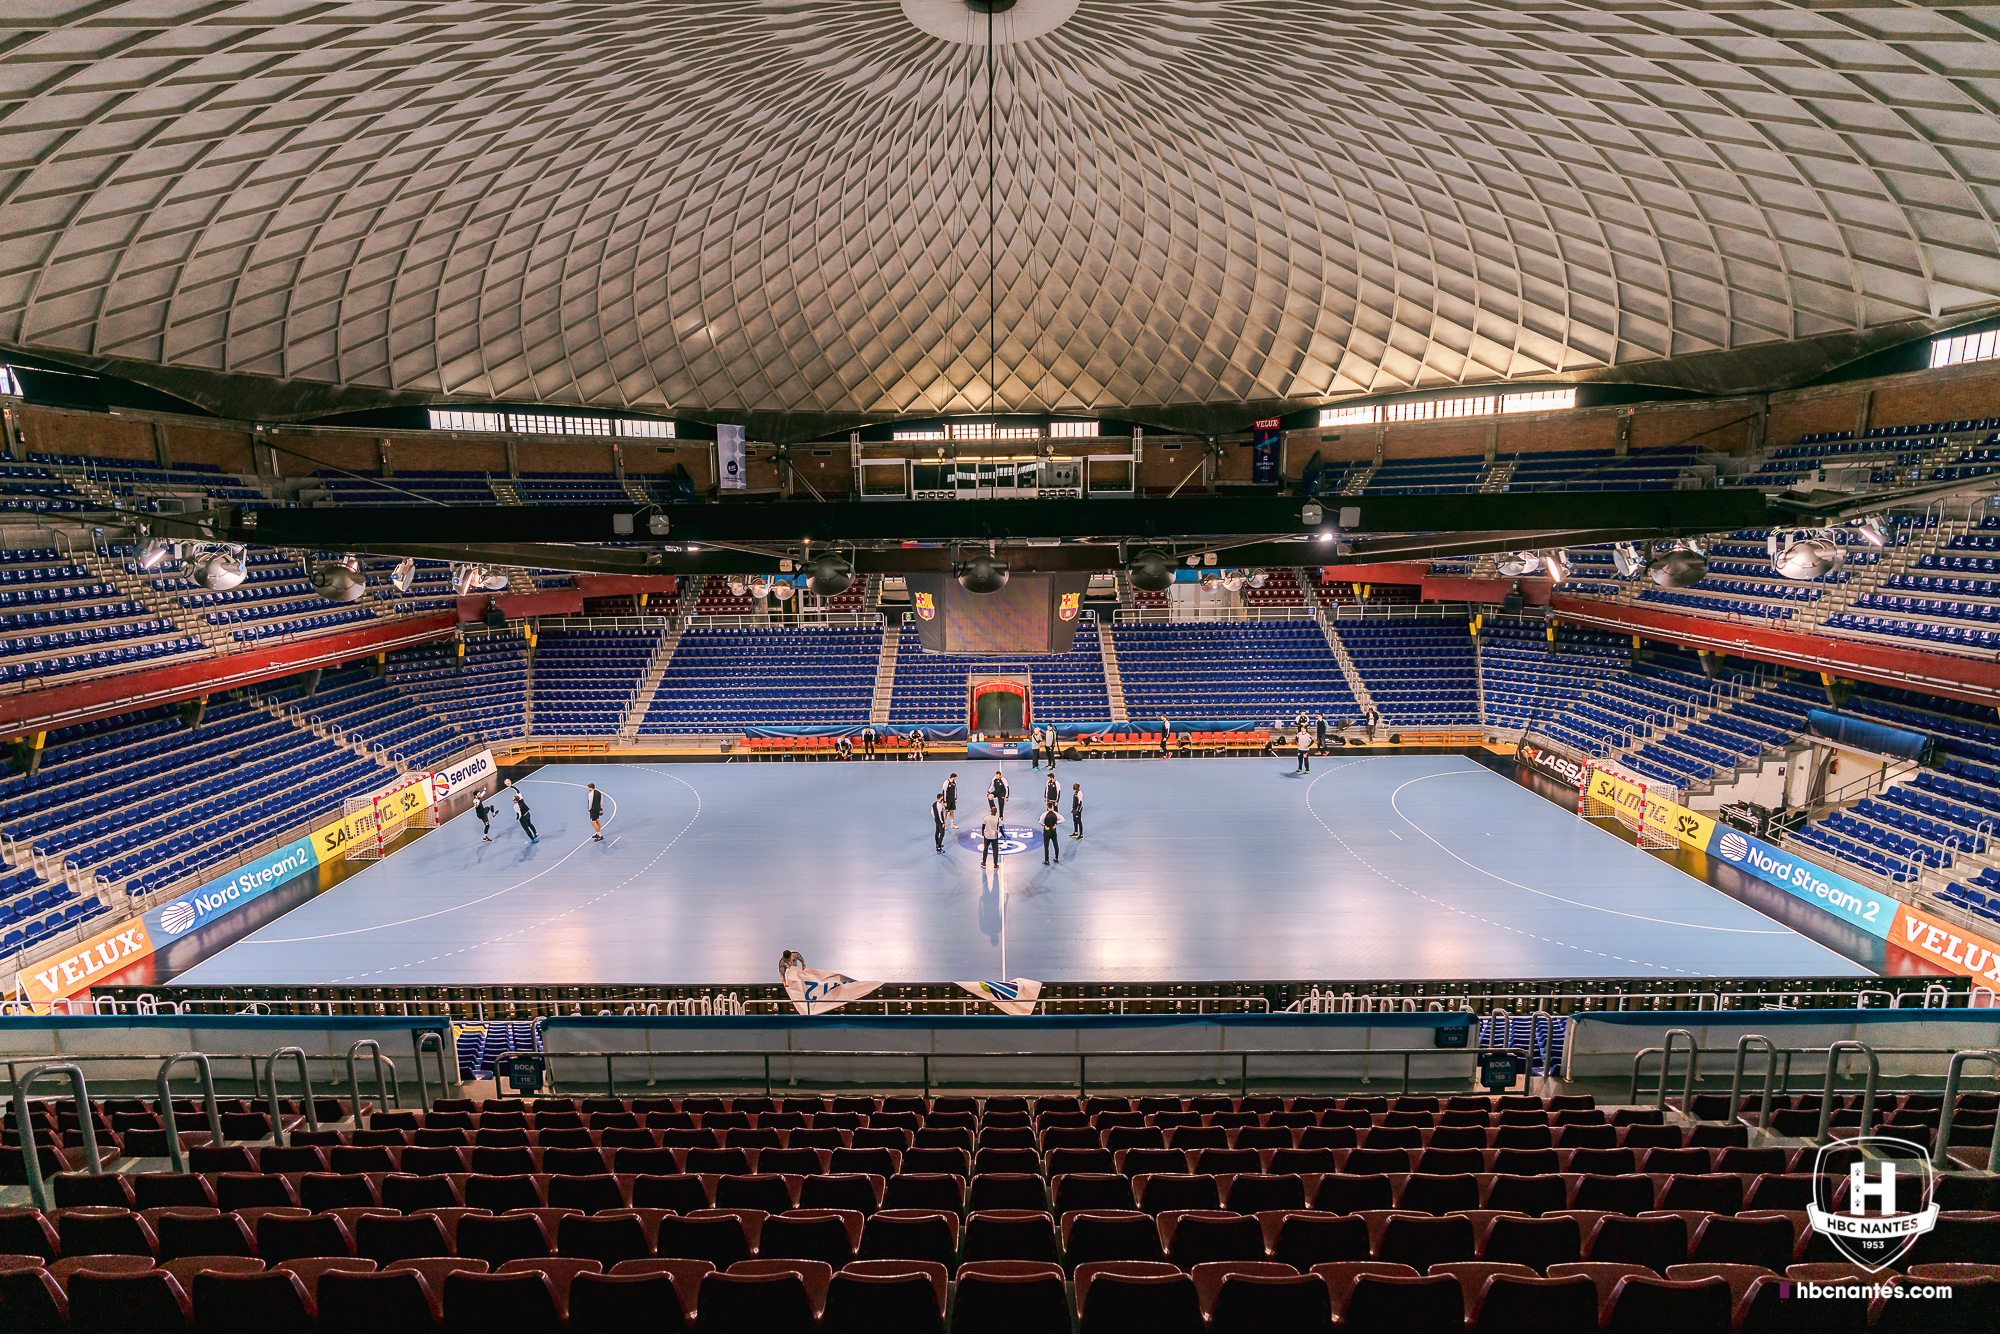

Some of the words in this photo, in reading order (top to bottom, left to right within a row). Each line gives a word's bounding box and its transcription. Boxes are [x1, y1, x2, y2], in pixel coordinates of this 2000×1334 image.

[1256, 420, 1278, 428] VELUX
[450, 757, 487, 786] serveto
[194, 882, 241, 917] Nord
[238, 854, 297, 894] Stream
[295, 847, 309, 865] 2
[1747, 846, 1796, 881] Nord
[1790, 866, 1863, 916] Stream
[1862, 900, 1881, 923] 2
[514, 1063, 535, 1071] BOCA
